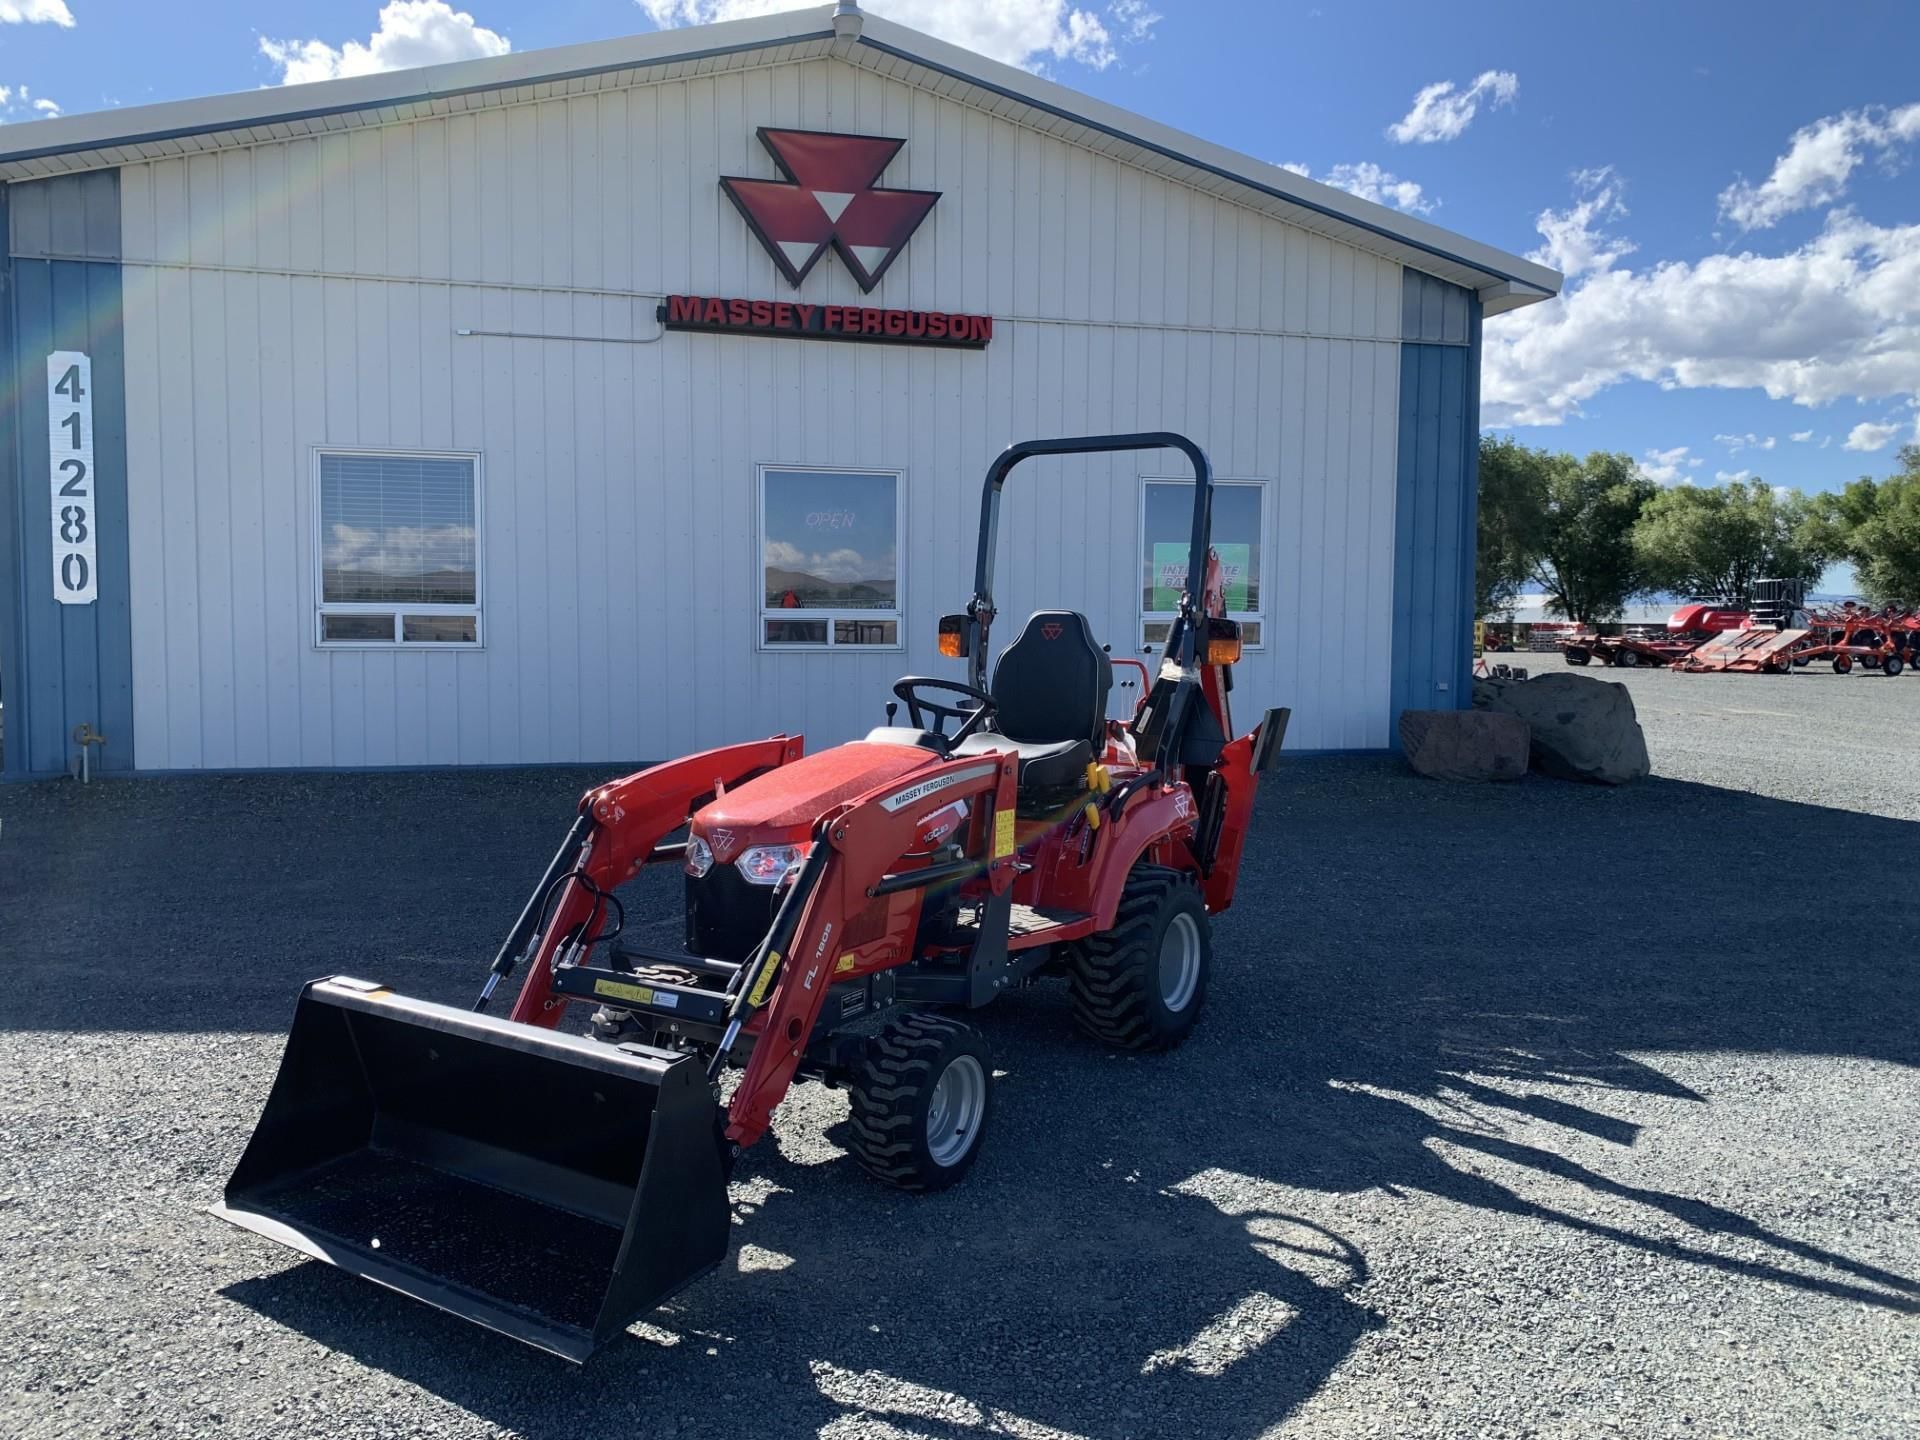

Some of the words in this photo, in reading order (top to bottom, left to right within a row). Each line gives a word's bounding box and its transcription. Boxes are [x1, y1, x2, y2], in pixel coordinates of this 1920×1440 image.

[669, 294, 817, 330] MASSEY
[823, 304, 993, 341] FERGUSON
[54, 364, 89, 592] 41280
[806, 509, 856, 529] OPEN
[895, 786, 922, 806] MASSEY
[922, 775, 955, 794] FERGUSON
[803, 965, 818, 990] FL
[815, 922, 832, 959] 1805
